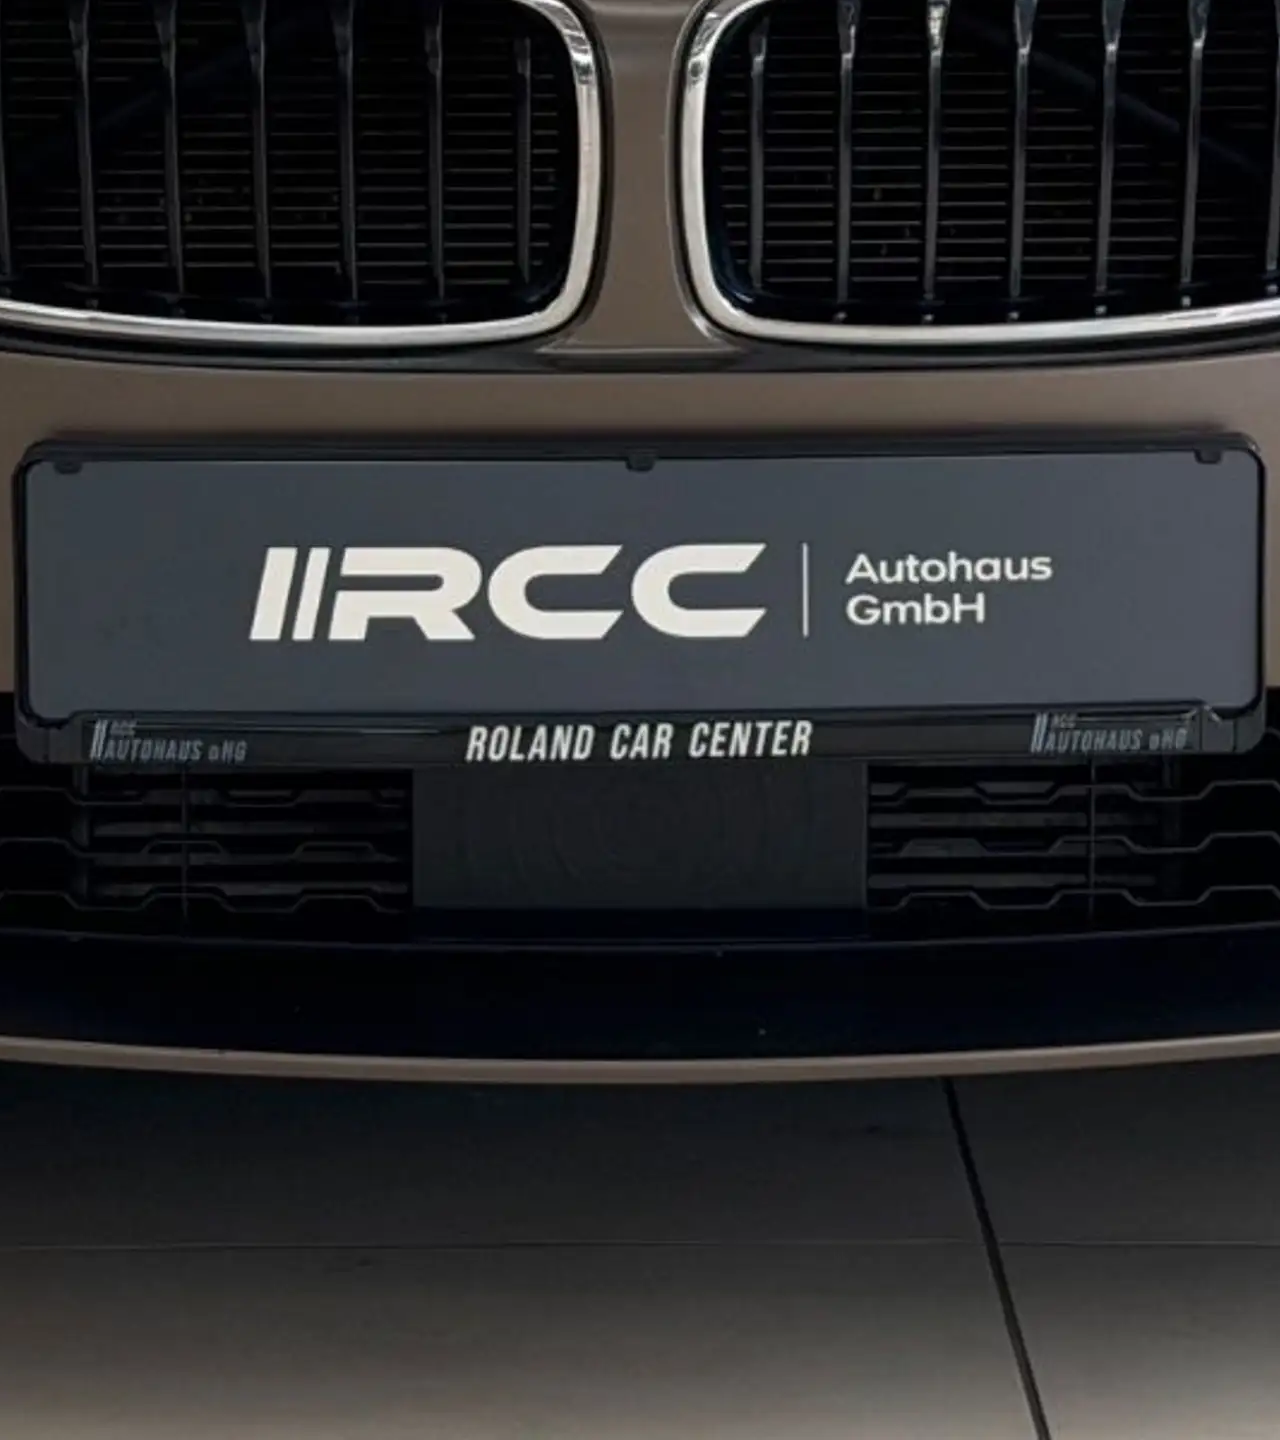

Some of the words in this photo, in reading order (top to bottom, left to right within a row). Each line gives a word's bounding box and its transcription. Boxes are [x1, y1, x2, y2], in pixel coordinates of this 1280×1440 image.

[845, 551, 1053, 584] Autohaus
[328, 543, 767, 641] RCC
[846, 592, 986, 625] GmbH
[105, 739, 204, 762] AUTOHAUS
[466, 724, 595, 762] ROLAND
[610, 722, 674, 759] CAR
[689, 720, 813, 758] CENTER
[1044, 729, 1143, 753] AUTOHAUS
